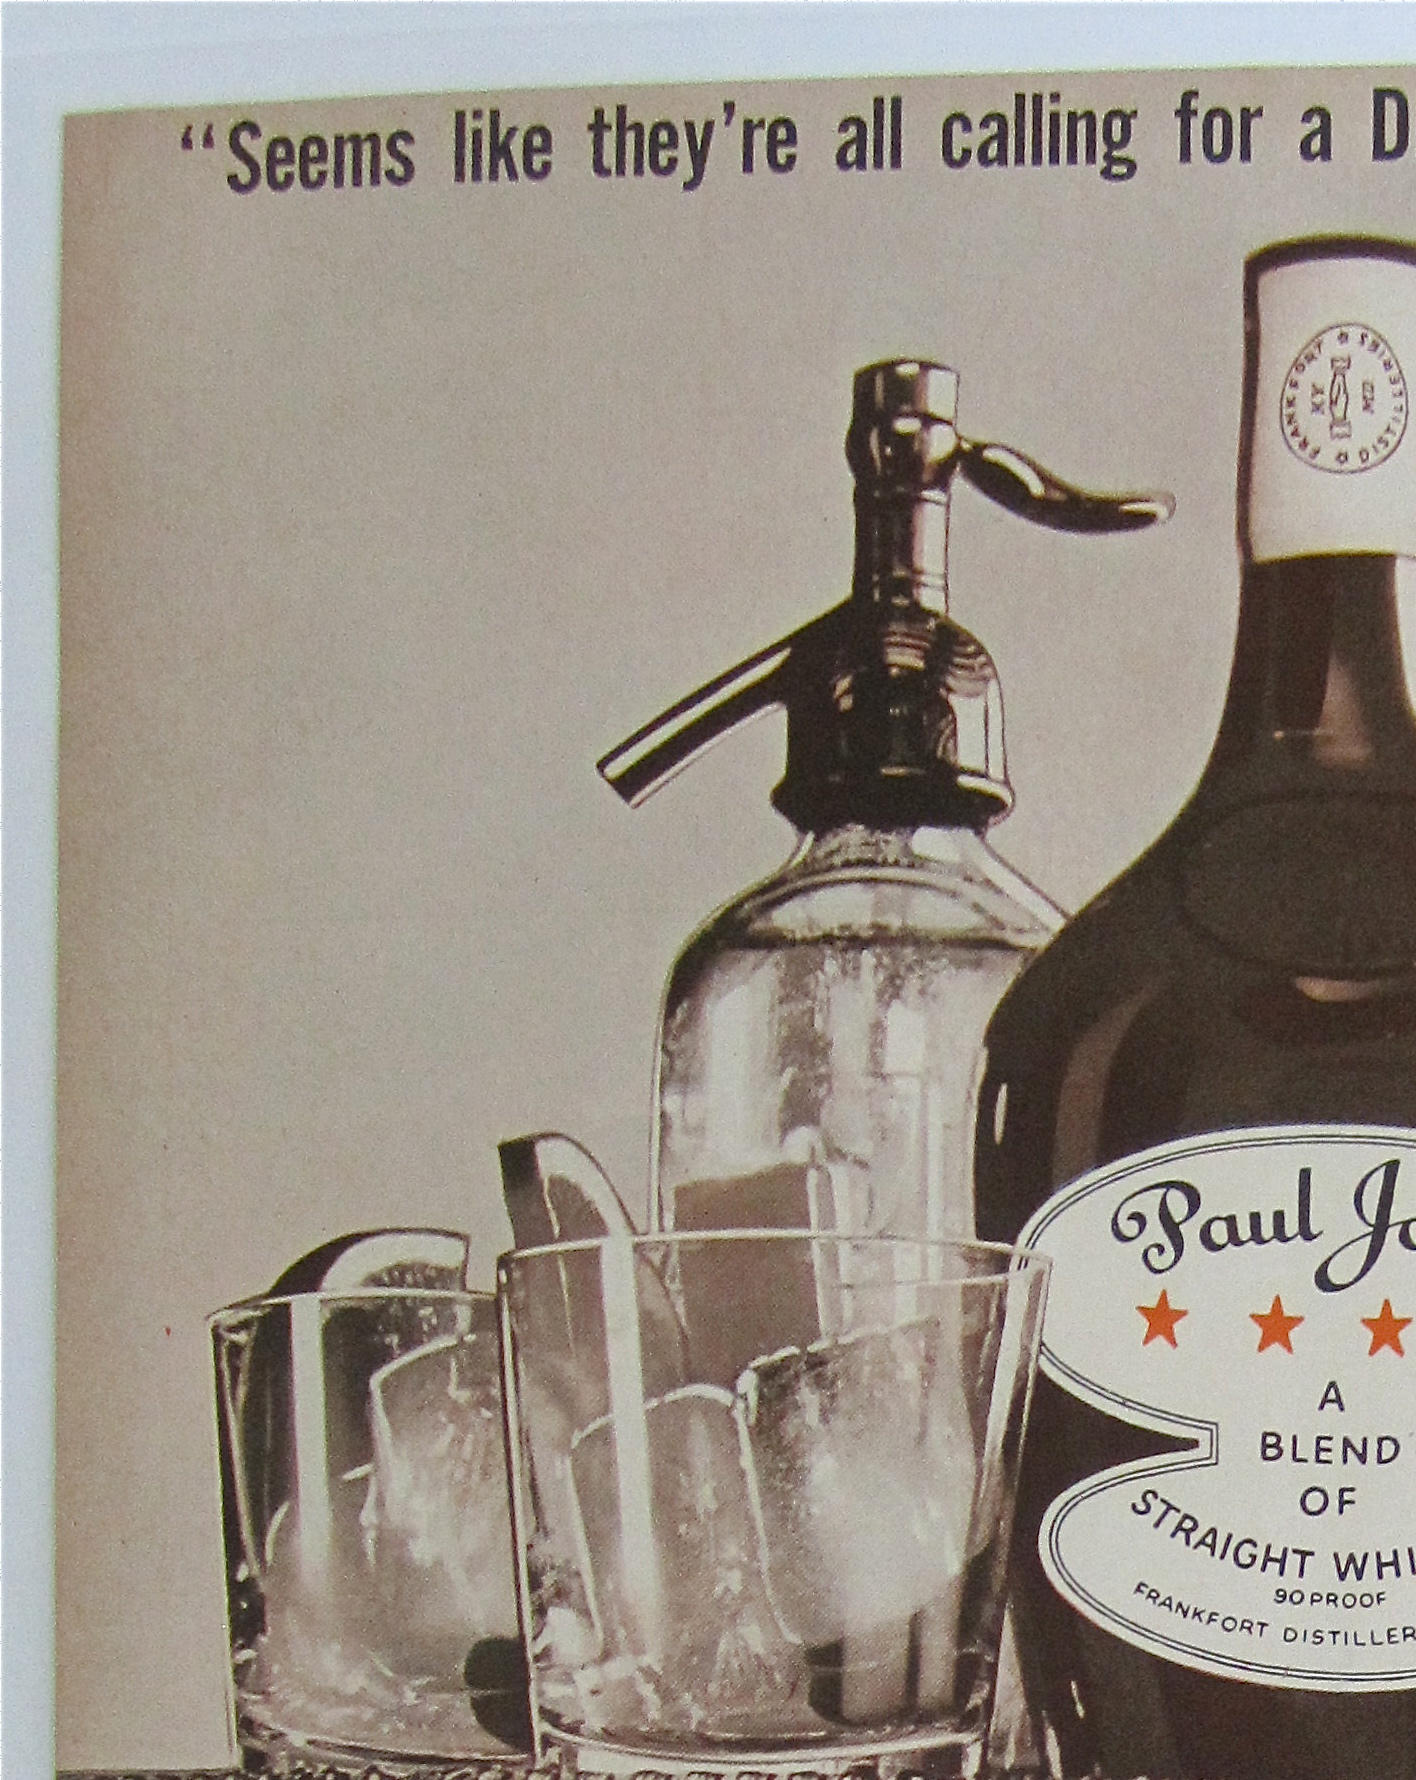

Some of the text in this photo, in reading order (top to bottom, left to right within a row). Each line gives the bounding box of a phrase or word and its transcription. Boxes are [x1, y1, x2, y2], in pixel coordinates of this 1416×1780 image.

[455, 109, 552, 182] like
[588, 101, 797, 191] they’re
[836, 96, 902, 170] all
[942, 92, 1137, 180] calling
[1175, 90, 1263, 163] for
[1300, 107, 1331, 161] a
[1111, 1167, 1322, 1273] Paul
[1319, 1381, 1344, 1411] A
[1261, 1432, 1400, 1464] BLEND
[1300, 1487, 1355, 1516] OF
[1131, 1488, 1315, 1577] STRAIGHT
[1134, 1582, 1268, 1637] FRANKFORT
